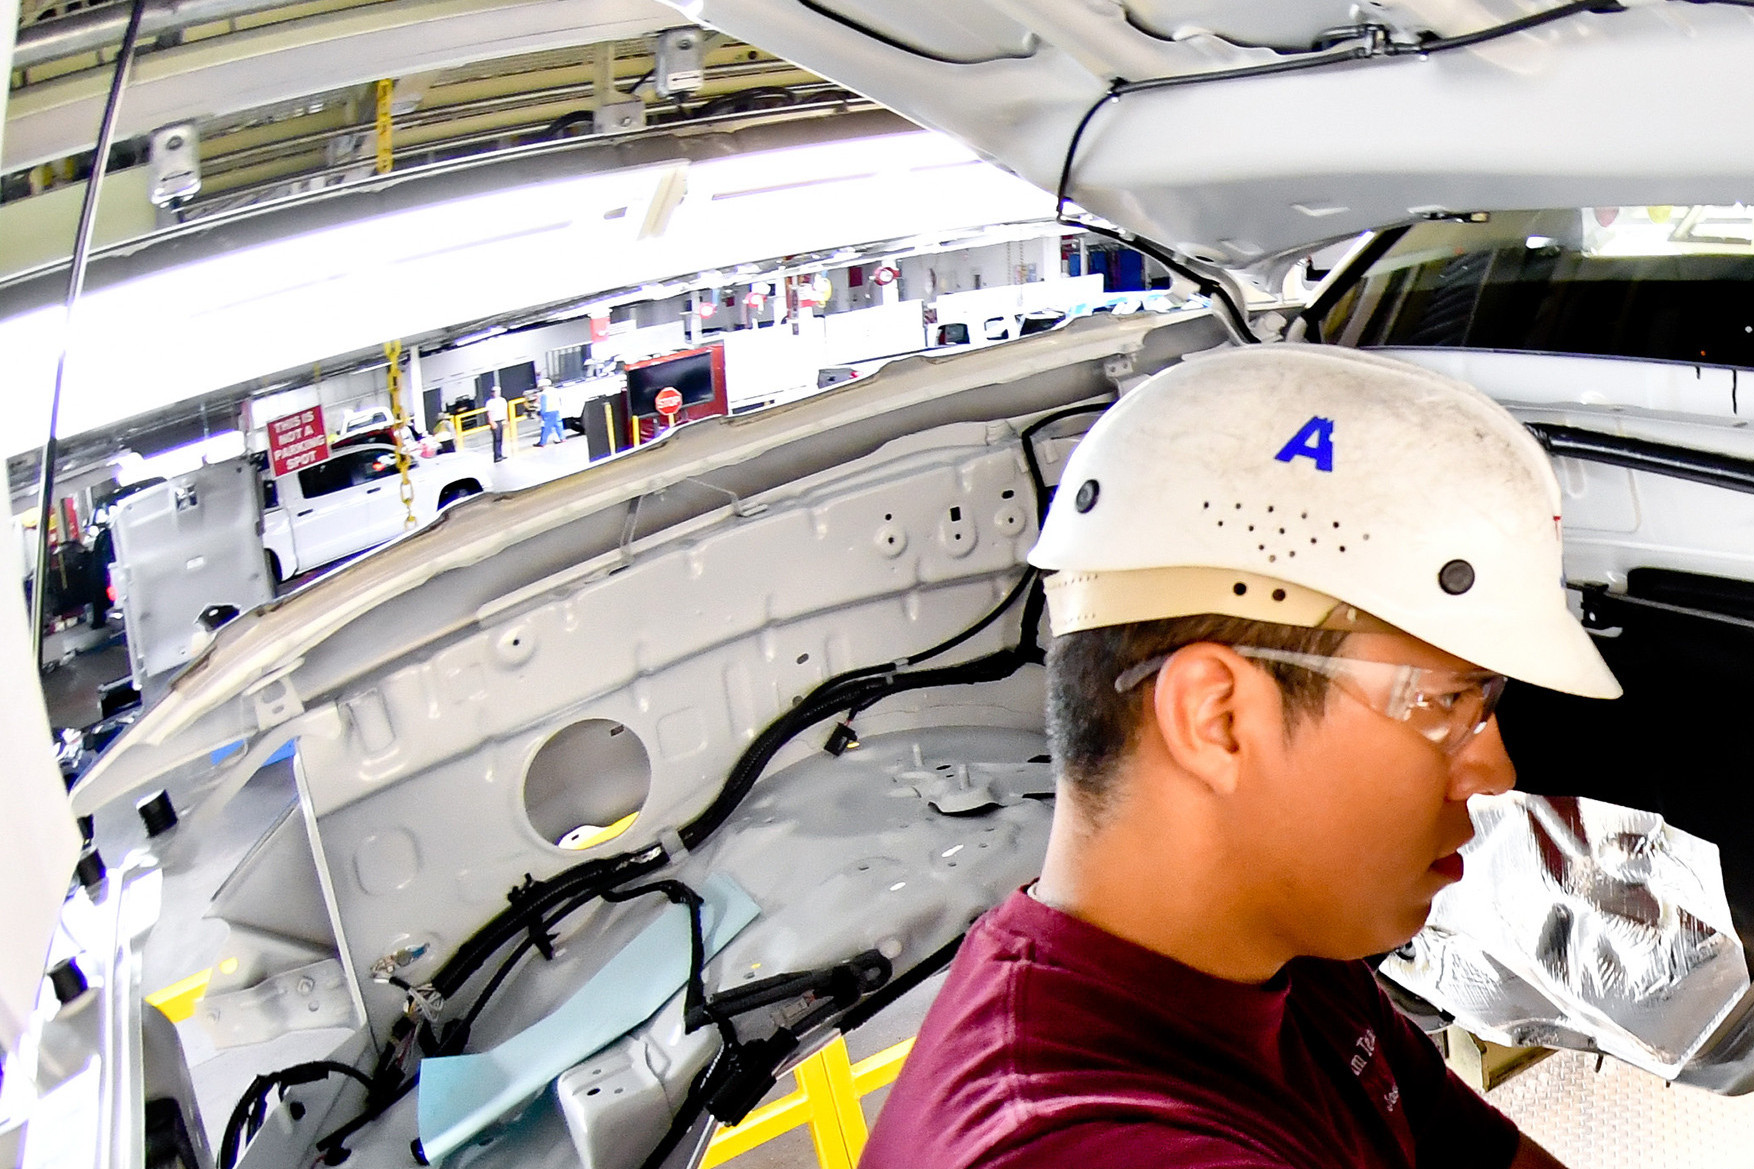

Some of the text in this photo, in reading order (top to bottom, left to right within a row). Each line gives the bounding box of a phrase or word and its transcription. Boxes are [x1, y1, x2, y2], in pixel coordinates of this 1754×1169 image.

[657, 396, 681, 409] STOP
[273, 410, 315, 433] THIS IS
[279, 425, 315, 446] NOT A
[1274, 416, 1333, 472] A
[274, 434, 325, 462] PARKING
[286, 450, 317, 470] SPOT
